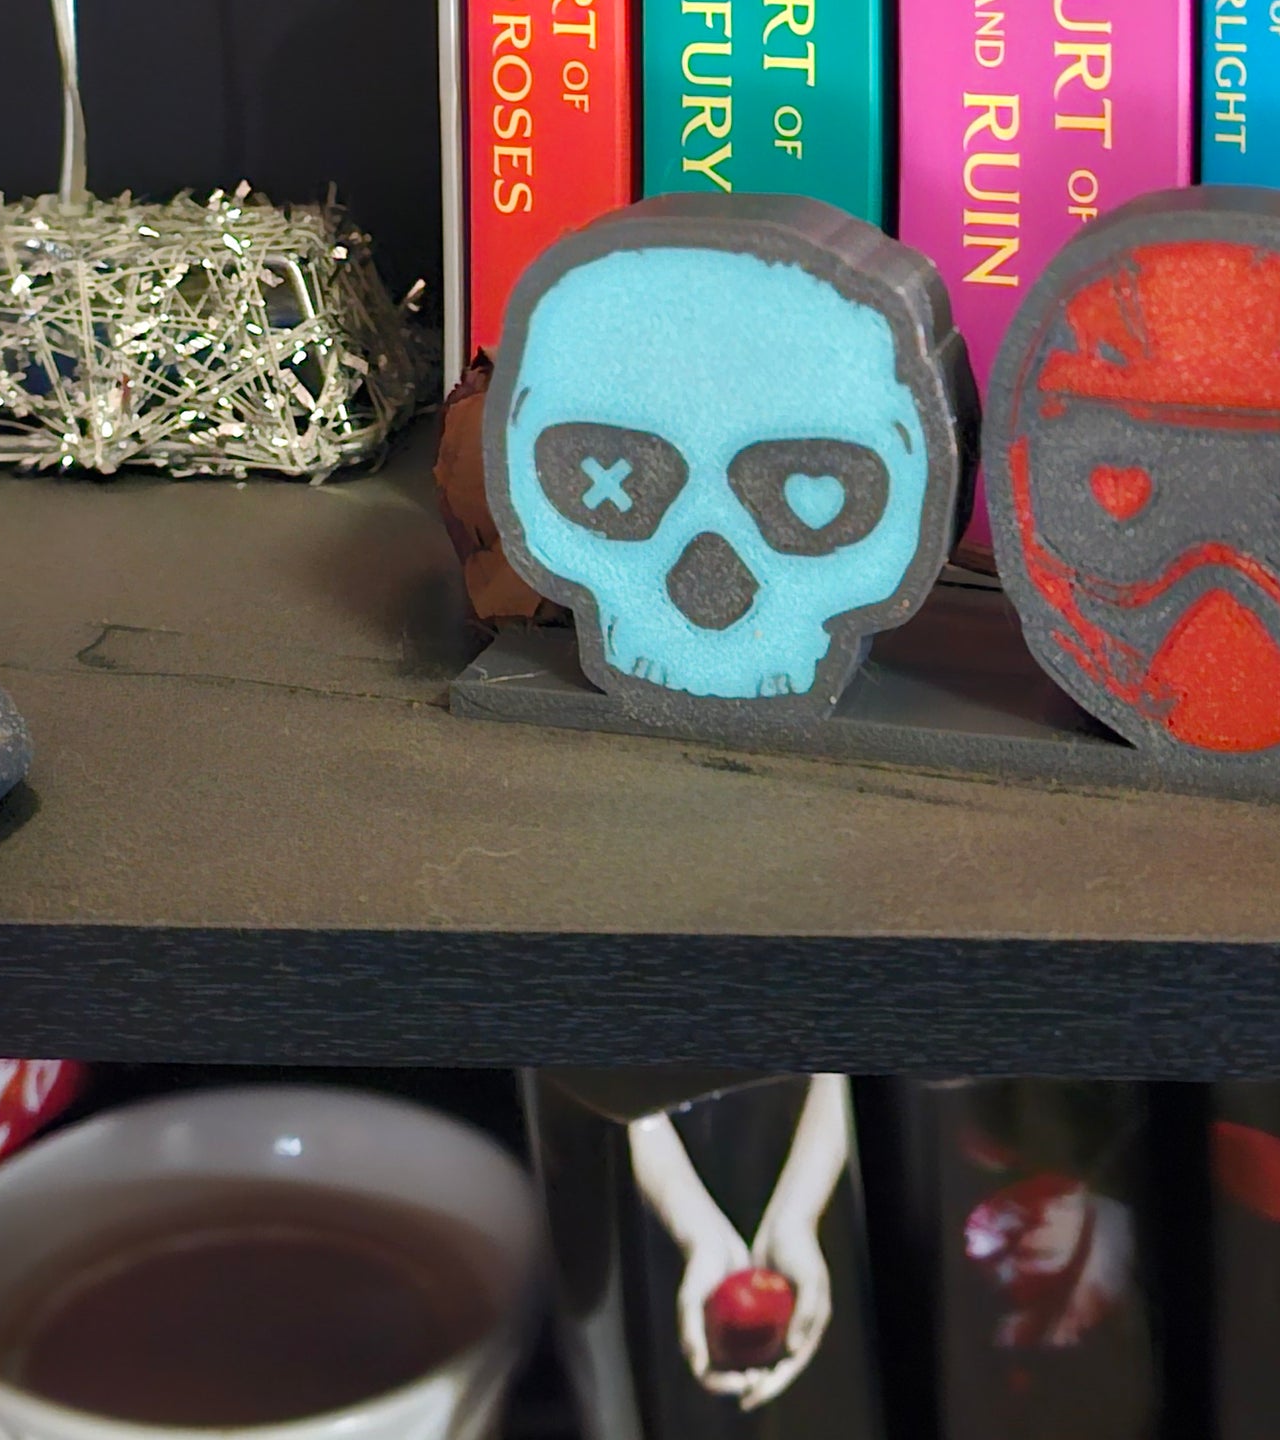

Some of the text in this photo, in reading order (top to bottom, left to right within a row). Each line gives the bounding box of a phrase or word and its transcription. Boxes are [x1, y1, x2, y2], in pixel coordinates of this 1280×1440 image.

[491, 14, 533, 214] ROSES
[562, 60, 590, 114] OF
[680, 0, 733, 194] FURY
[773, 105, 803, 160] OF
[961, 91, 1020, 287] RUIN
[1067, 169, 1099, 223] OF
